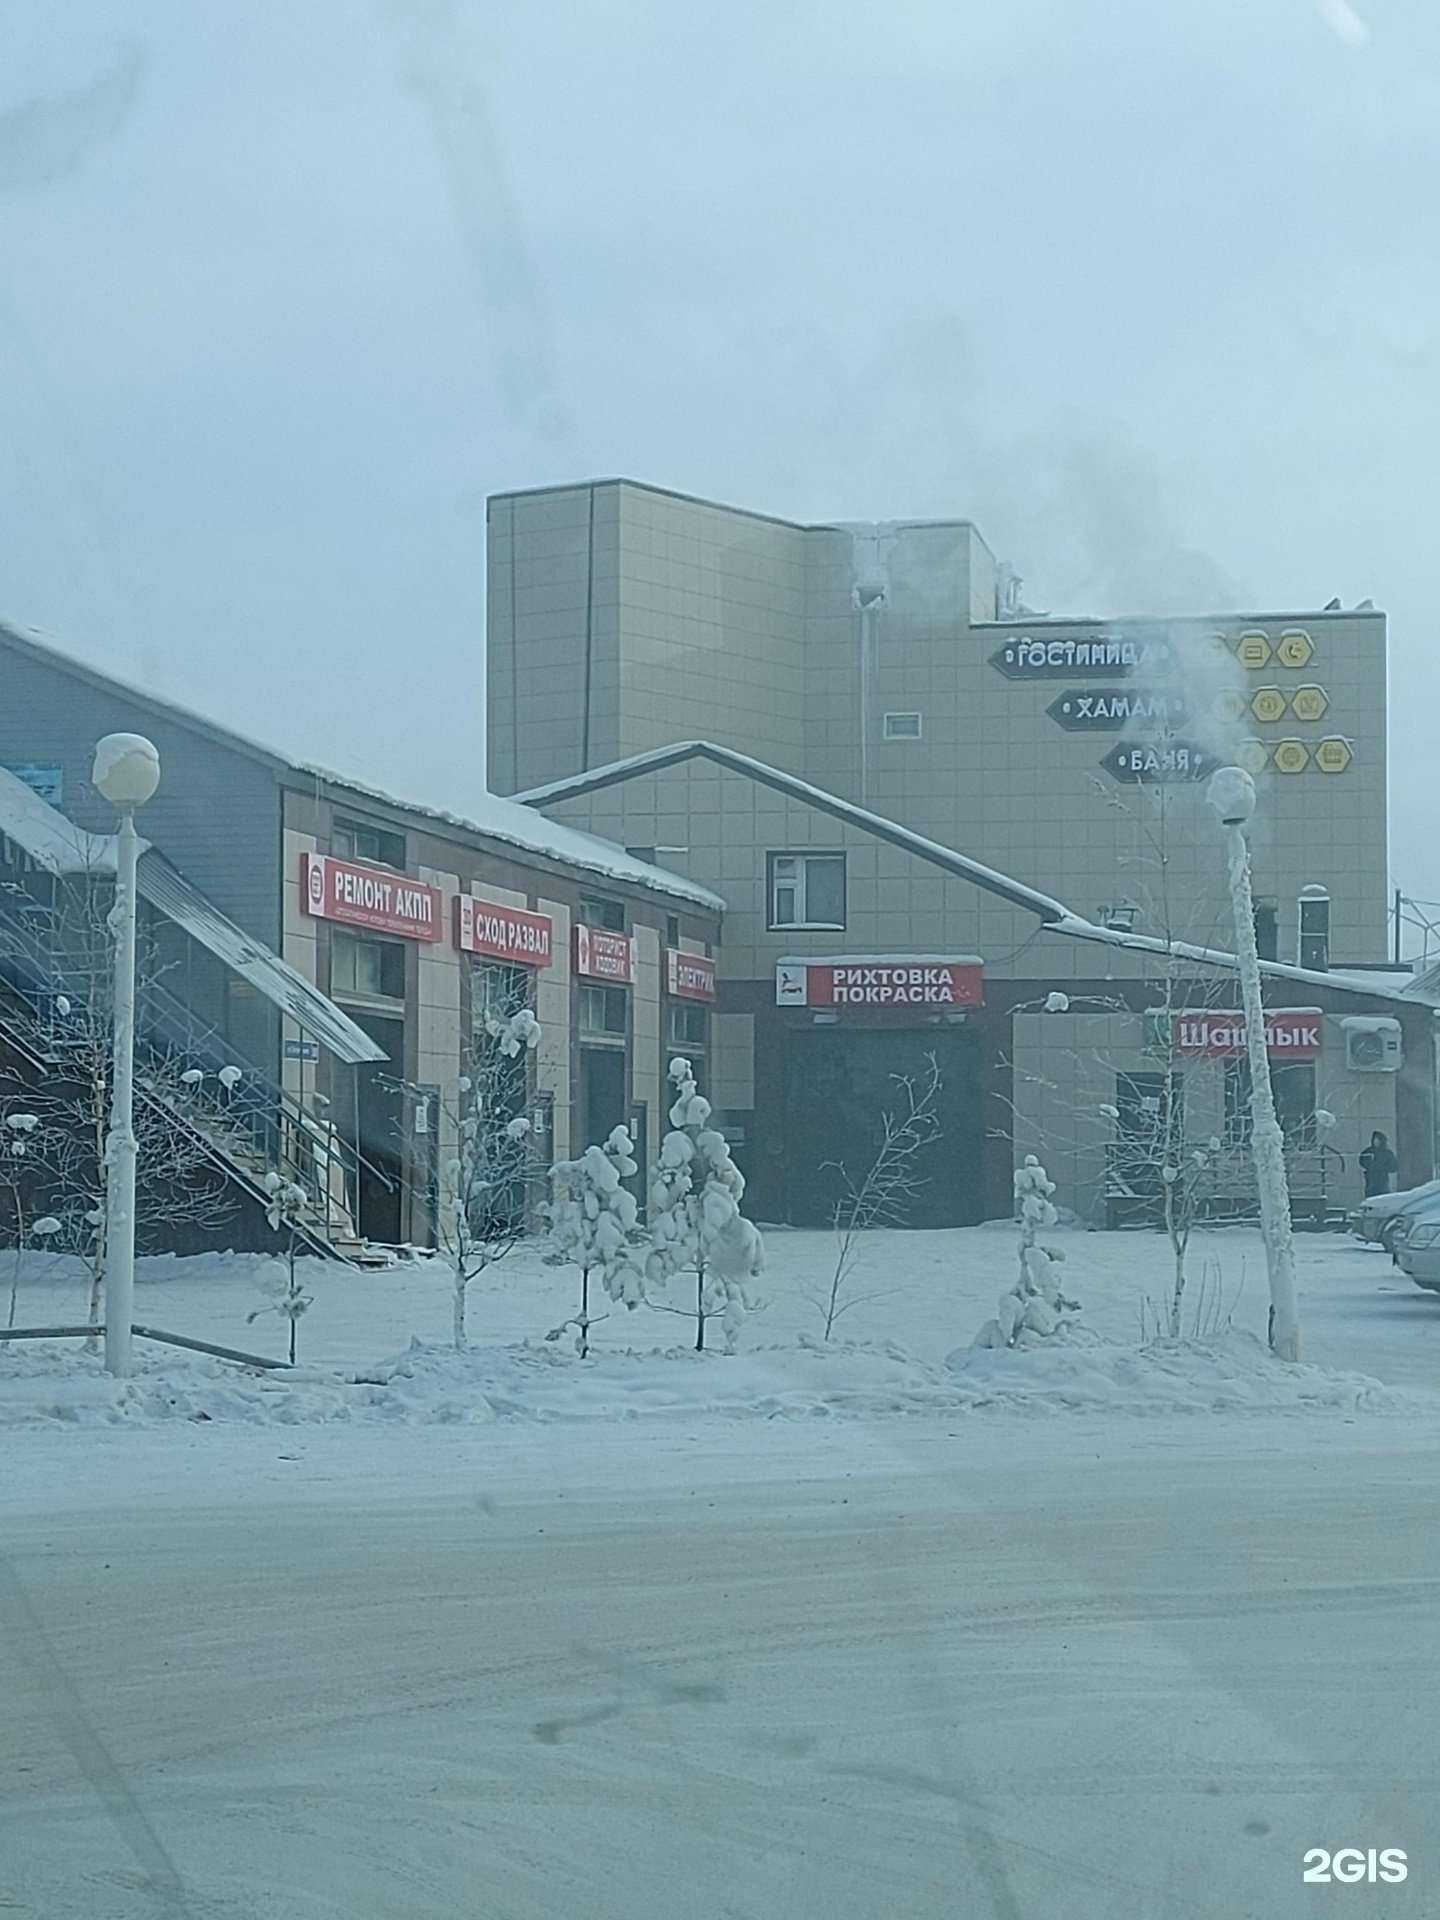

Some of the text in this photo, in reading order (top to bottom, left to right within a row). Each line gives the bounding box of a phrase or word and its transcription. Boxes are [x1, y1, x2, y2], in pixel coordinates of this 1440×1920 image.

[1018, 641, 1153, 667] ГОСТИНИЦА
[1076, 697, 1168, 718] ХАМАМ
[1131, 749, 1190, 771] БАНЯ
[335, 870, 432, 922] РЕМОНТ АКПП
[476, 913, 507, 951] СХОД
[508, 921, 549, 955] РАЗВАЛ
[833, 969, 954, 985] РИХТОВКА
[833, 986, 954, 1002] ПОКРАСКА
